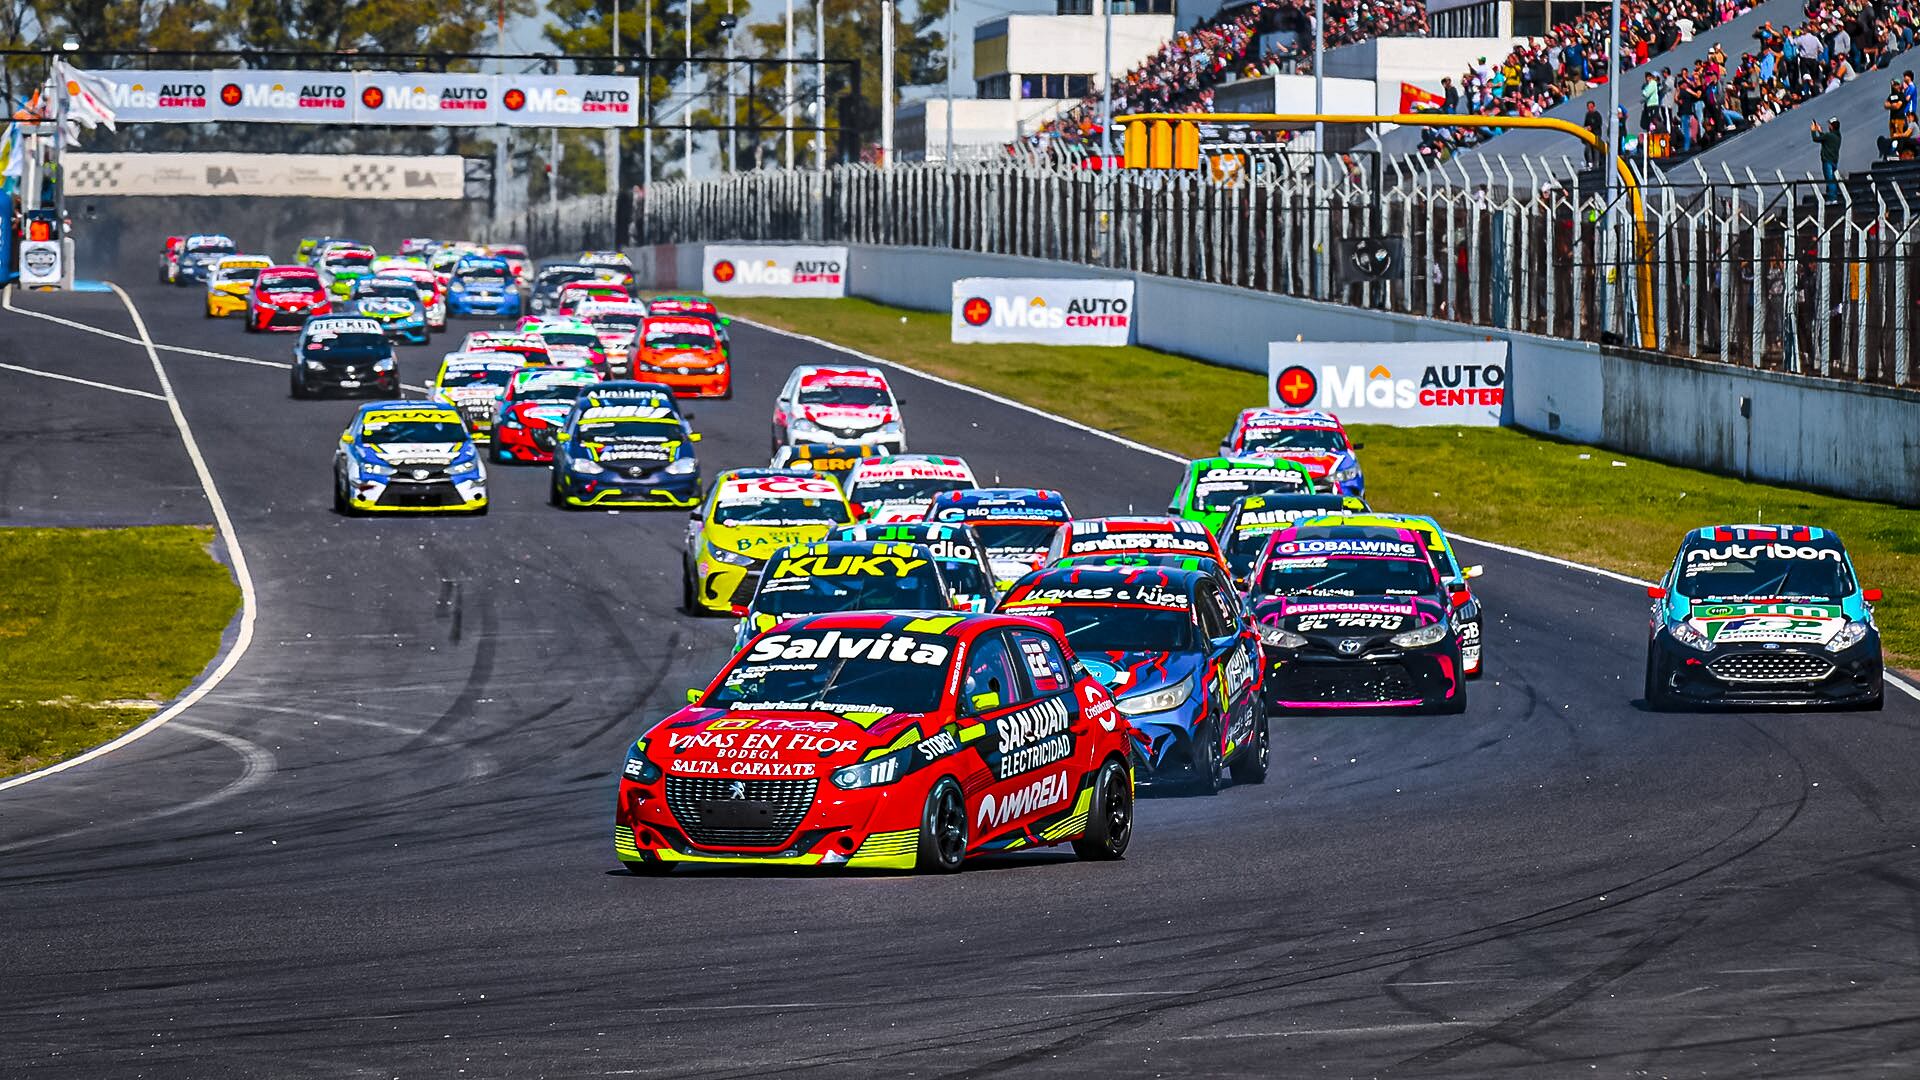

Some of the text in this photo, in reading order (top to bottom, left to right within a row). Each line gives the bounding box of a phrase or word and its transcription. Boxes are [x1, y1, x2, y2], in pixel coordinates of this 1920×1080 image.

[159, 85, 206, 97] AUTO
[300, 85, 346, 98] AUTO
[441, 88, 488, 100] AUTO
[584, 90, 629, 102] AUTO
[794, 260, 841, 273] AUTO
[792, 273, 840, 284] CENTER
[1067, 298, 1127, 314] AUTO
[1066, 314, 1127, 328] CENTER
[1420, 364, 1505, 388] AUTO
[1418, 387, 1504, 407] CENTER
[733, 482, 836, 494] TCG
[990, 507, 1063, 517] GALLEGOS
[1280, 540, 1416, 554] GLOBALWING
[1686, 543, 1842, 561] nutribon
[773, 556, 928, 578] KUKY
[747, 630, 949, 667] Salvita
[730, 700, 895, 715] Parabrisas Pergamino
[996, 696, 1069, 754] SAN JUAN
[668, 731, 858, 752] VIÑAS EN FLOR
[917, 731, 959, 761] STOREY
[717, 749, 779, 760] BODEGA
[1000, 735, 1071, 779] ELECTRICIDAD
[671, 760, 720, 774] SALTA
[731, 761, 816, 776] CAFAYATE
